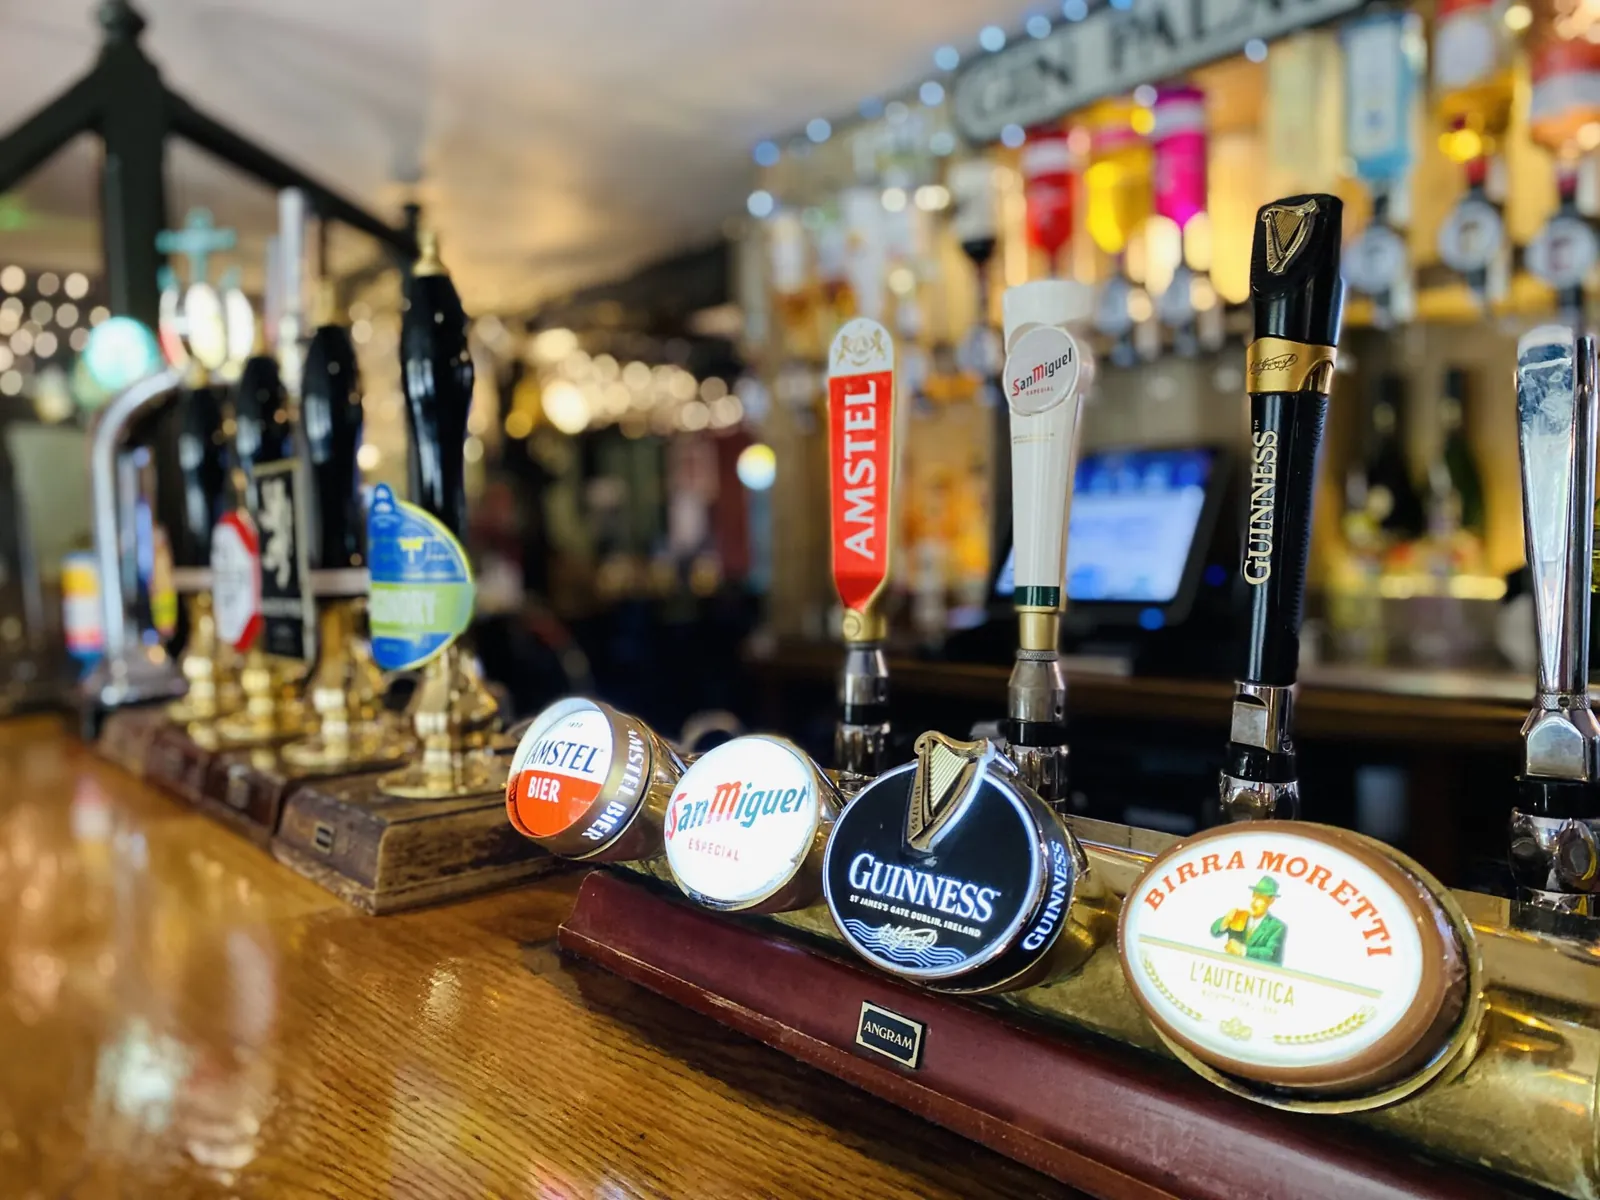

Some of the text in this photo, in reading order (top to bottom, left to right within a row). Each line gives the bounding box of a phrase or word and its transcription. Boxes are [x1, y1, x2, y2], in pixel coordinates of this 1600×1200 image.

[843, 380, 877, 561] AMSTEL
[1243, 428, 1278, 586] GUINNESS
[526, 740, 601, 774] AMSTEL
[581, 725, 645, 841] AMSTEL BIER
[527, 776, 561, 803] BIER
[688, 837, 740, 862] ESPECIAL
[849, 853, 995, 923] GUINNESS
[849, 894, 860, 903] ST
[859, 897, 889, 912] JAMES'S
[890, 906, 909, 918] GATE
[943, 920, 982, 938] IRELAND
[1022, 840, 1069, 951] GUINNESS
[1144, 851, 1393, 957] BIRRA MORETTI
[1190, 960, 1296, 1007] L'AUTENTICA
[863, 1020, 913, 1050] ANGRAM
